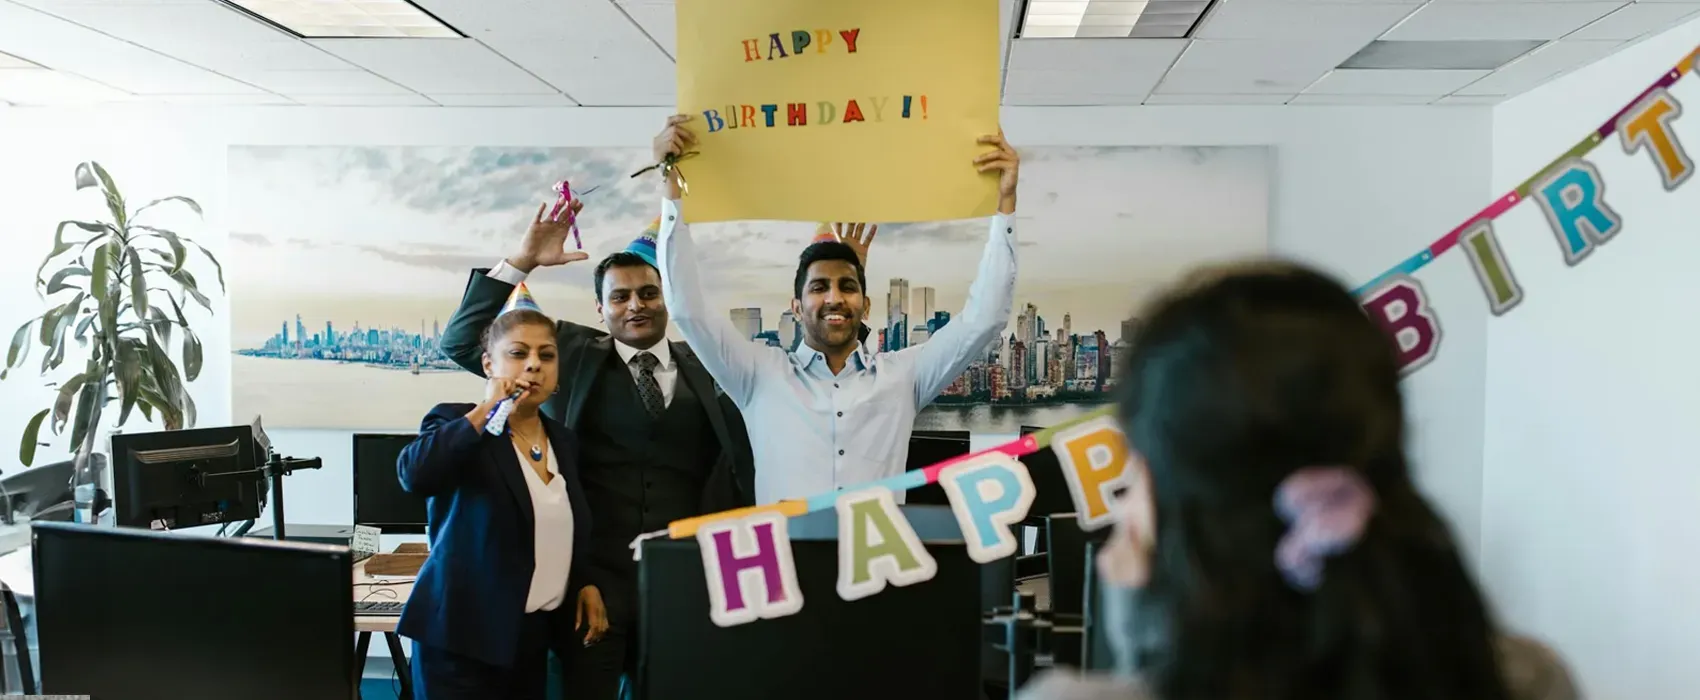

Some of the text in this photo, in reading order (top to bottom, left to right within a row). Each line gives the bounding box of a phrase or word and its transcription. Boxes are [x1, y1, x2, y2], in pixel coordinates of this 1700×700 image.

[741, 28, 860, 62] HAPPY
[711, 97, 1687, 613] HAPP BIRT
